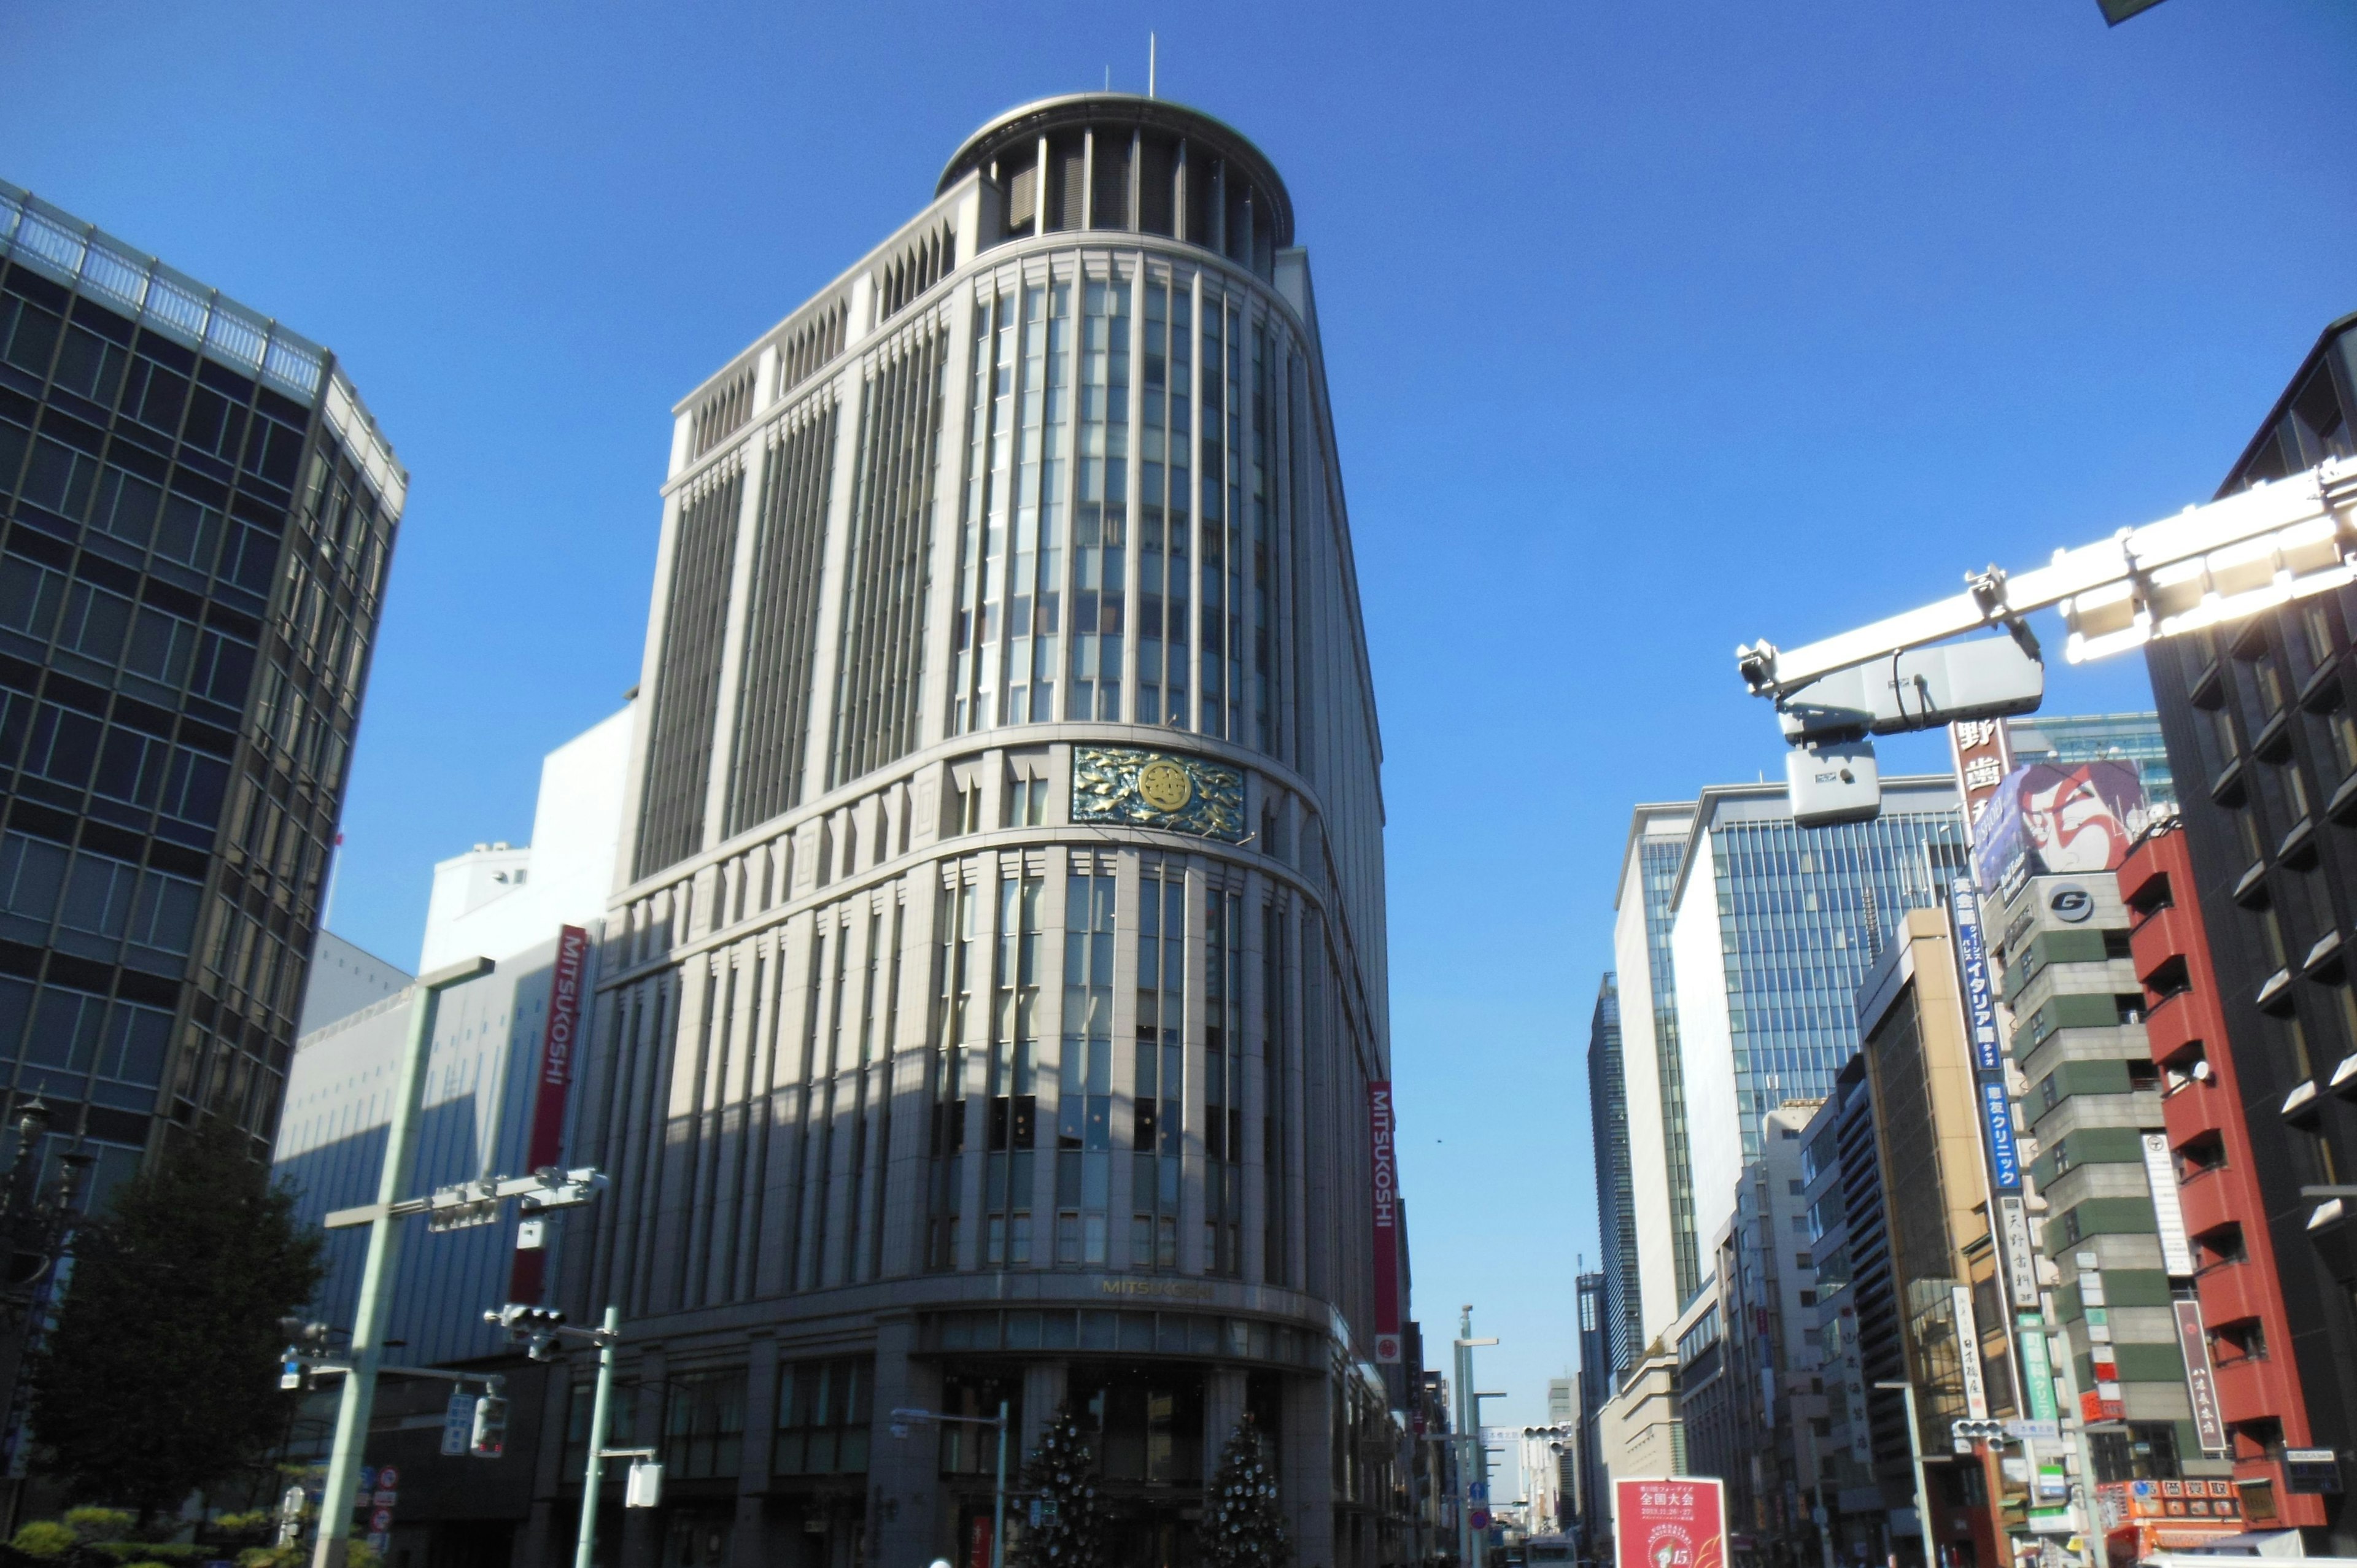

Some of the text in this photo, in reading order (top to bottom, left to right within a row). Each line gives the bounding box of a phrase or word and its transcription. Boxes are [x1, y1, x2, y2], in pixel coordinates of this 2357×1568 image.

[546, 936, 581, 1084] MITSUKOSHI
[1374, 1091, 1391, 1227] MITSUKOSHI
[1640, 1493, 1694, 1505] 全国大会
